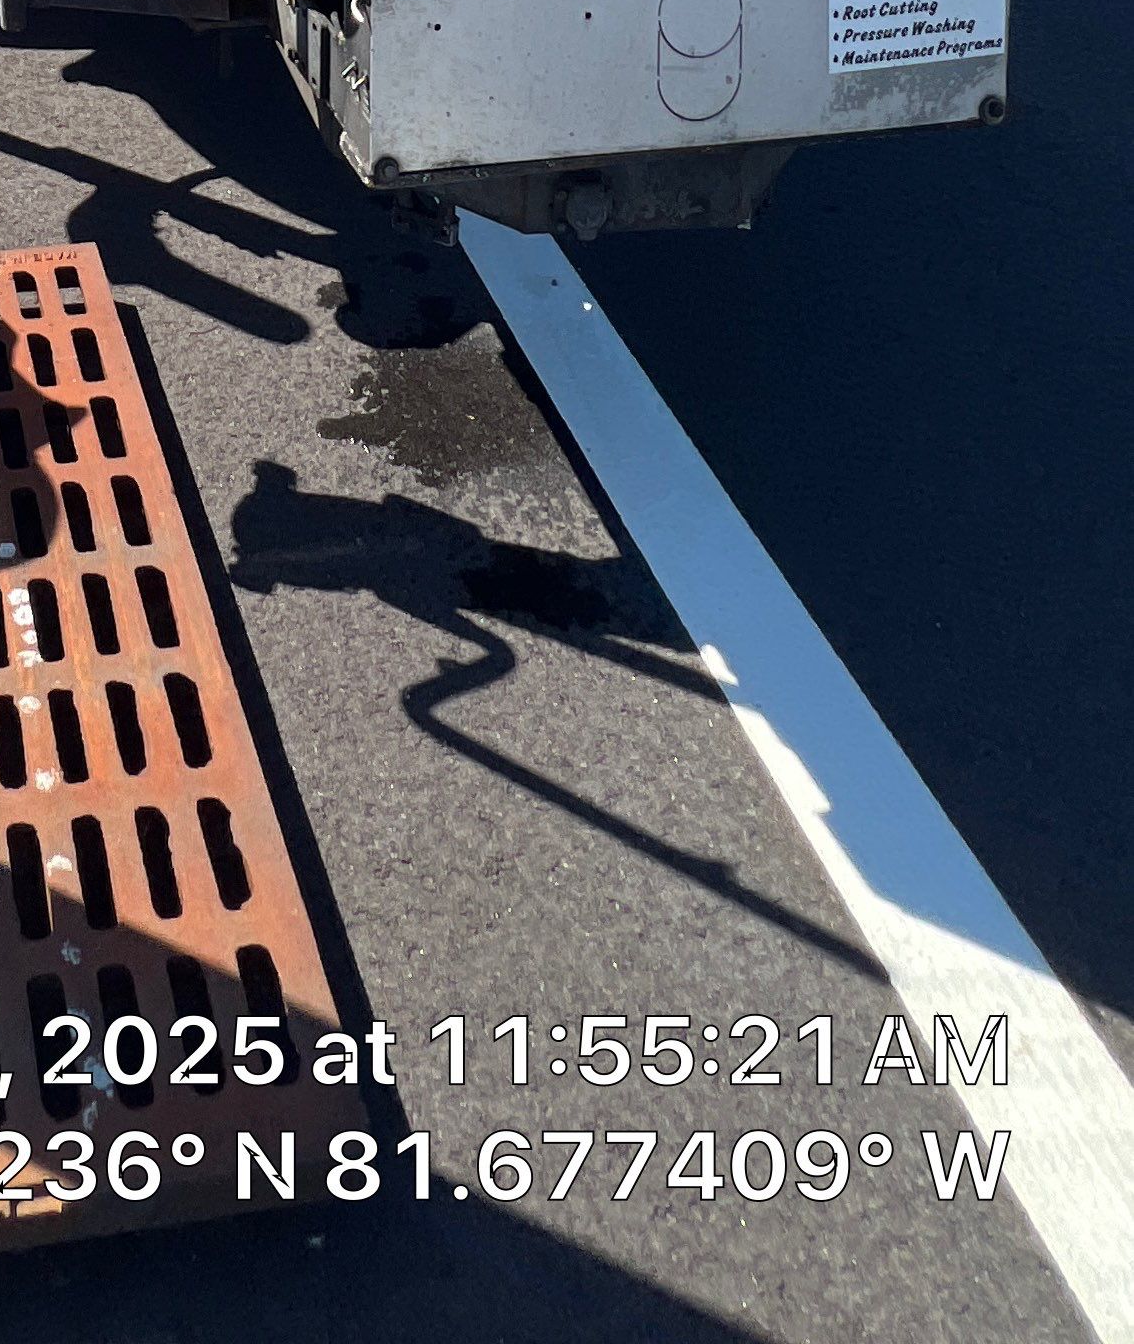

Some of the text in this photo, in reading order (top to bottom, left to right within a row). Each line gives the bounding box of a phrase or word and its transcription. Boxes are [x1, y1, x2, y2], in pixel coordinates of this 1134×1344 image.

[842, 0, 939, 21] Root Cutting
[842, 17, 976, 43] Pressure Washing
[841, 37, 1004, 66] Maintenance Programs
